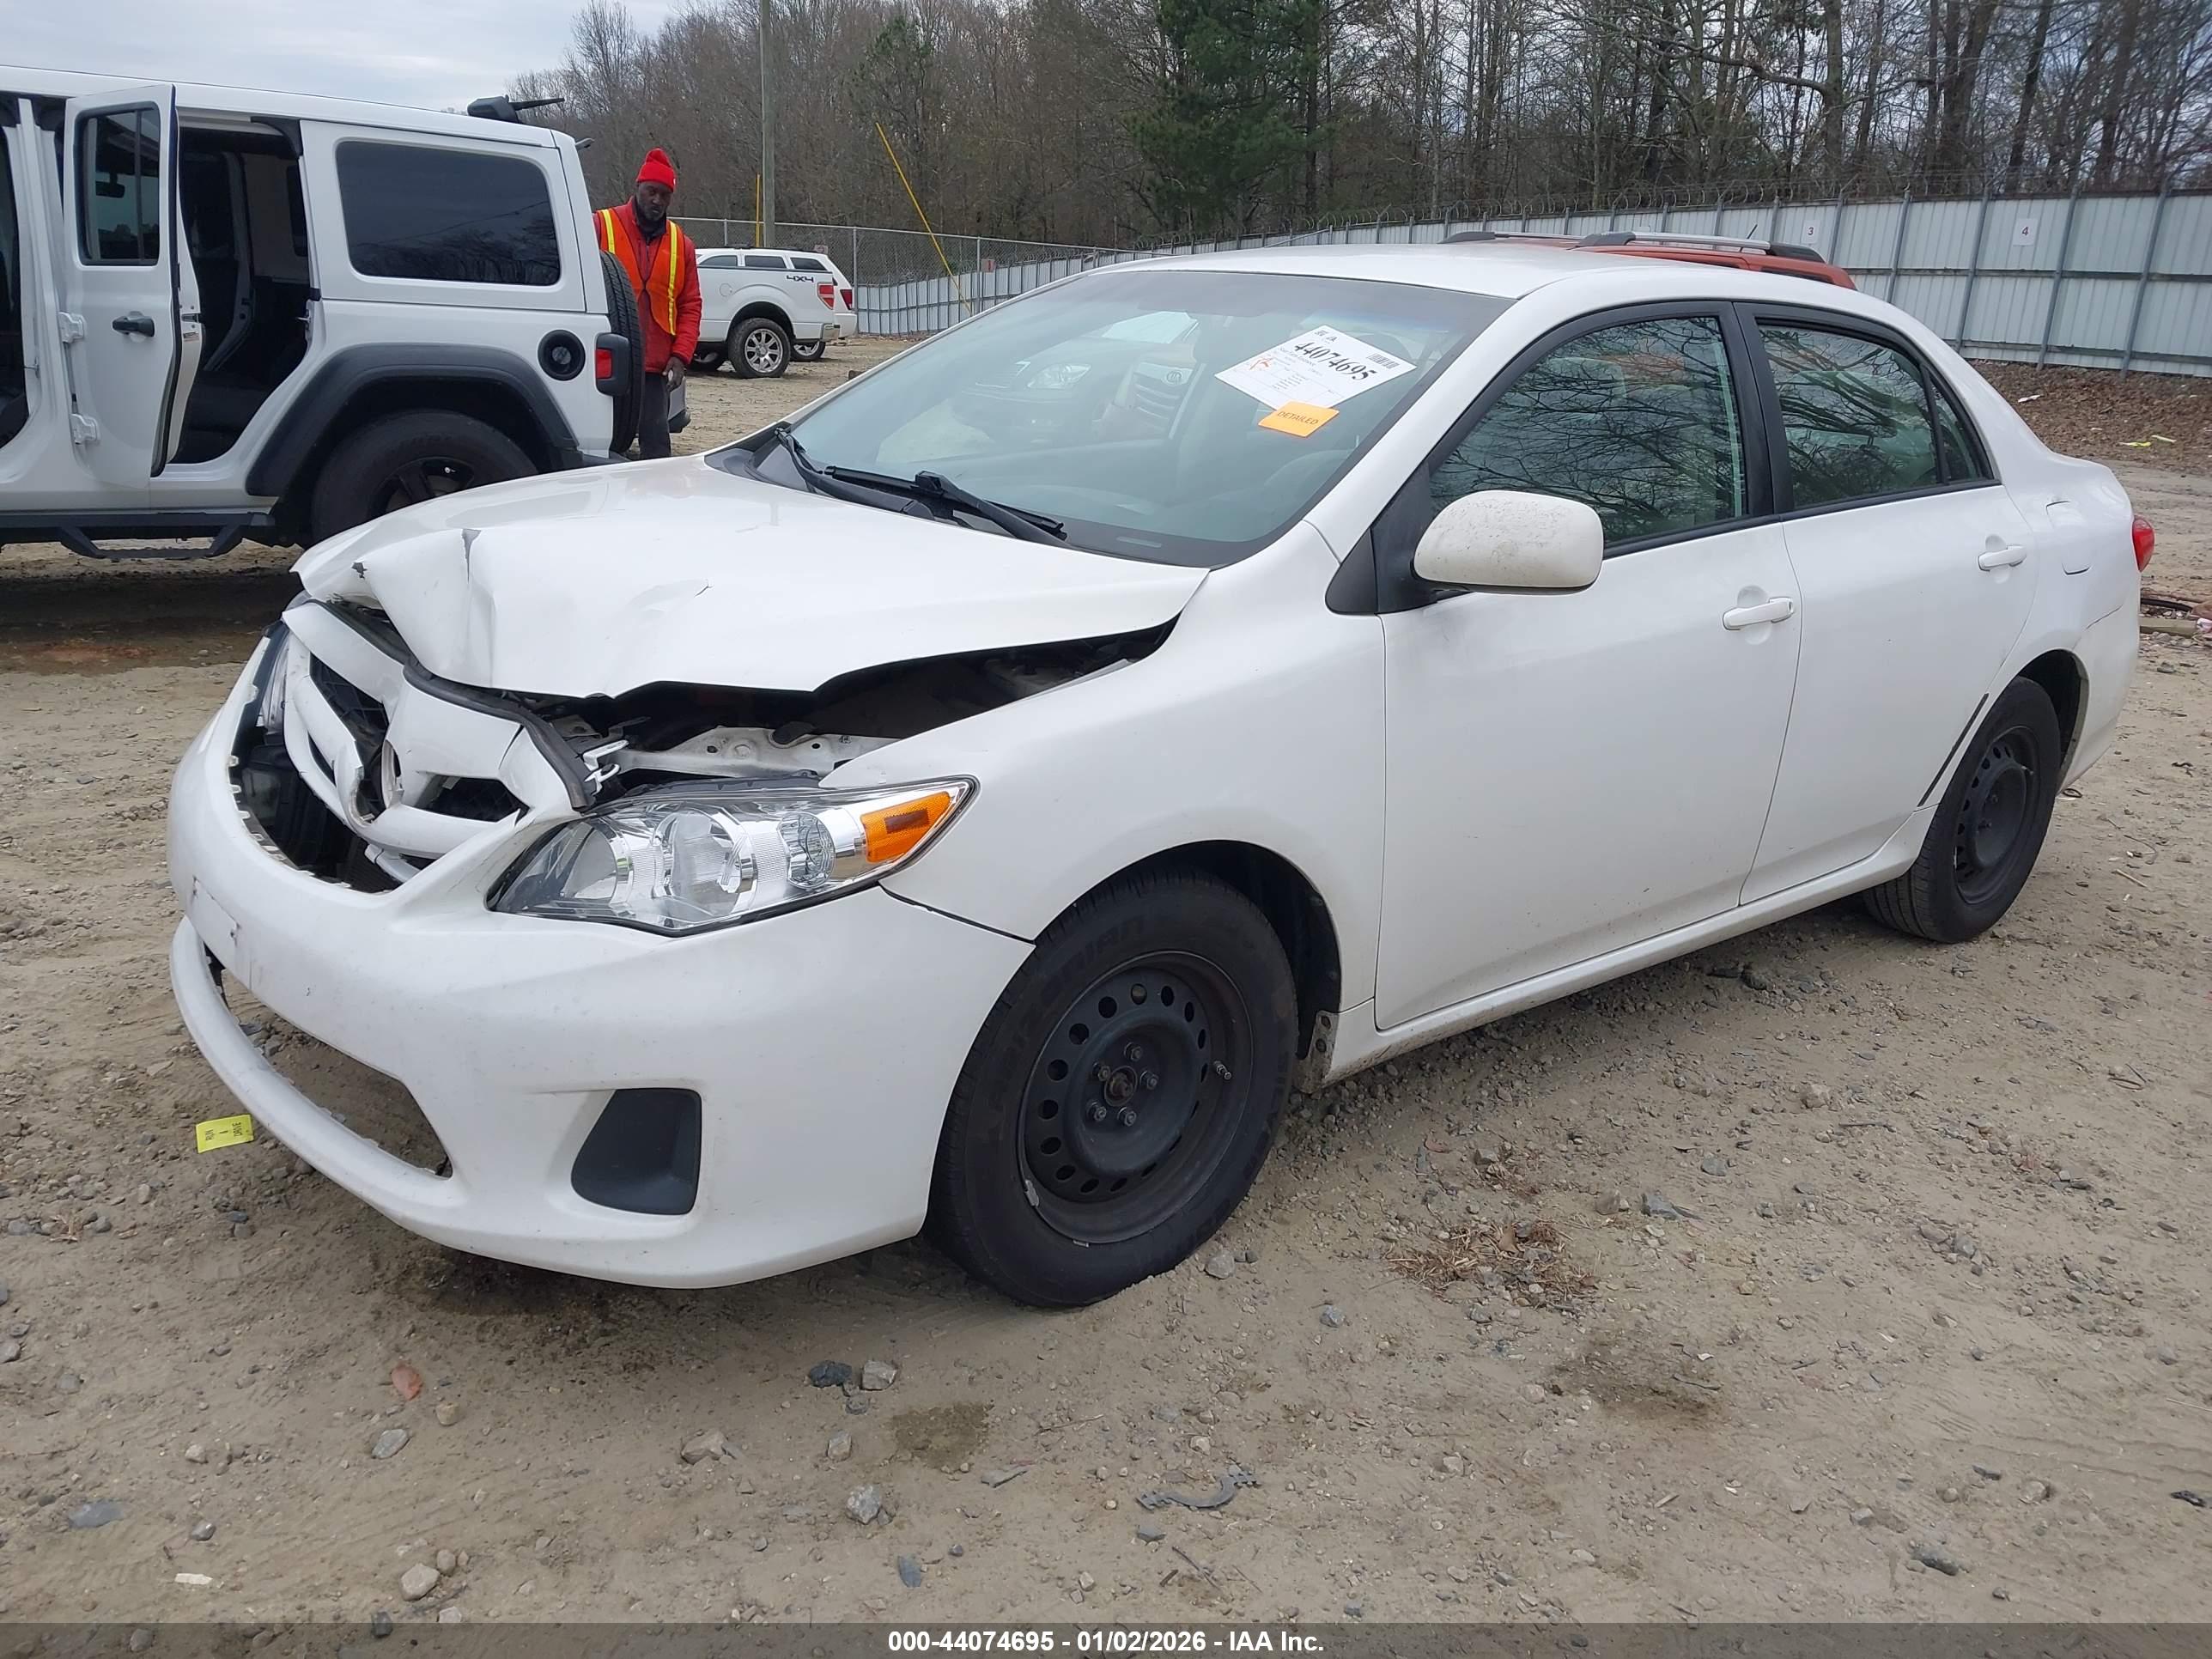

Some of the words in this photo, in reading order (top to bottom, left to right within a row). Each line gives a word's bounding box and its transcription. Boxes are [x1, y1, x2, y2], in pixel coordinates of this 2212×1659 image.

[1808, 226, 1814, 236] 3
[2021, 226, 2029, 236] 4
[786, 275, 814, 283] 4X4
[1294, 342, 1377, 380] 44074695
[1277, 410, 1320, 425] DETAILED
